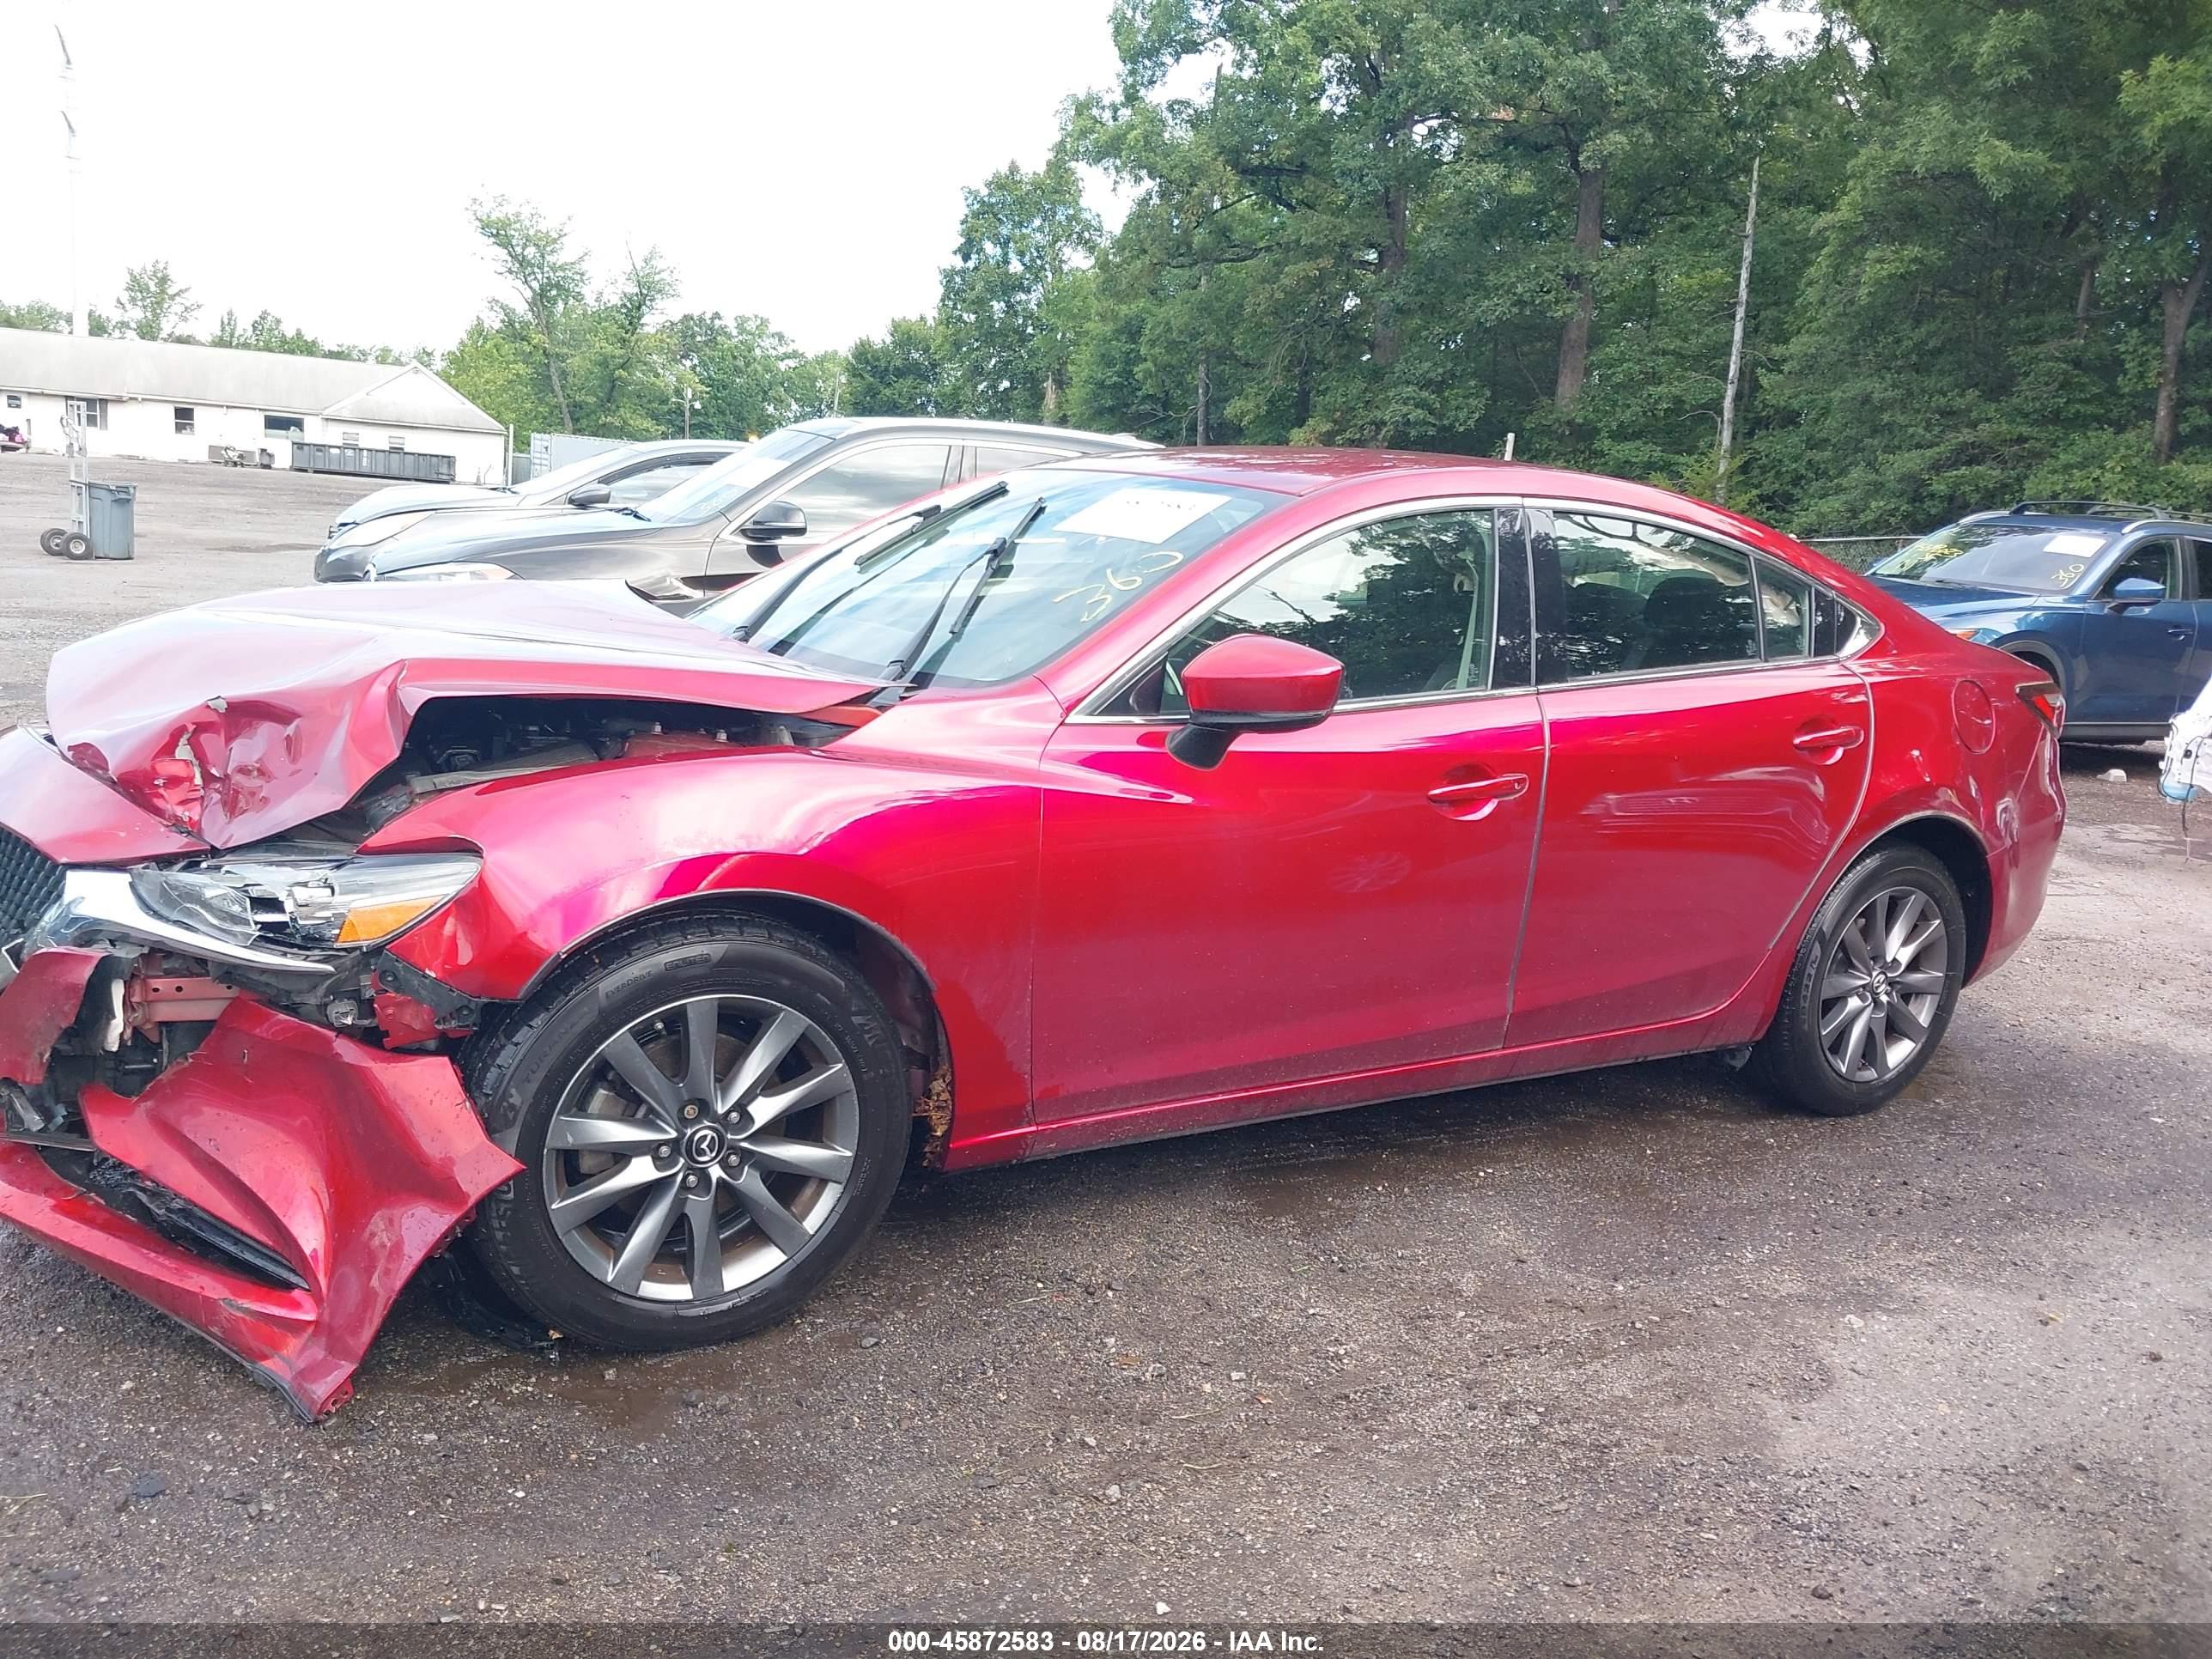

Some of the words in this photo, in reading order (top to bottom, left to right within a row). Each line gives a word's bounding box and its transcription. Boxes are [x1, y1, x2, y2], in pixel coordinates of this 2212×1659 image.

[1051, 550, 1184, 623] 360
[2050, 563, 2086, 588] 360
[605, 969, 653, 1000] EVERDRIVE
